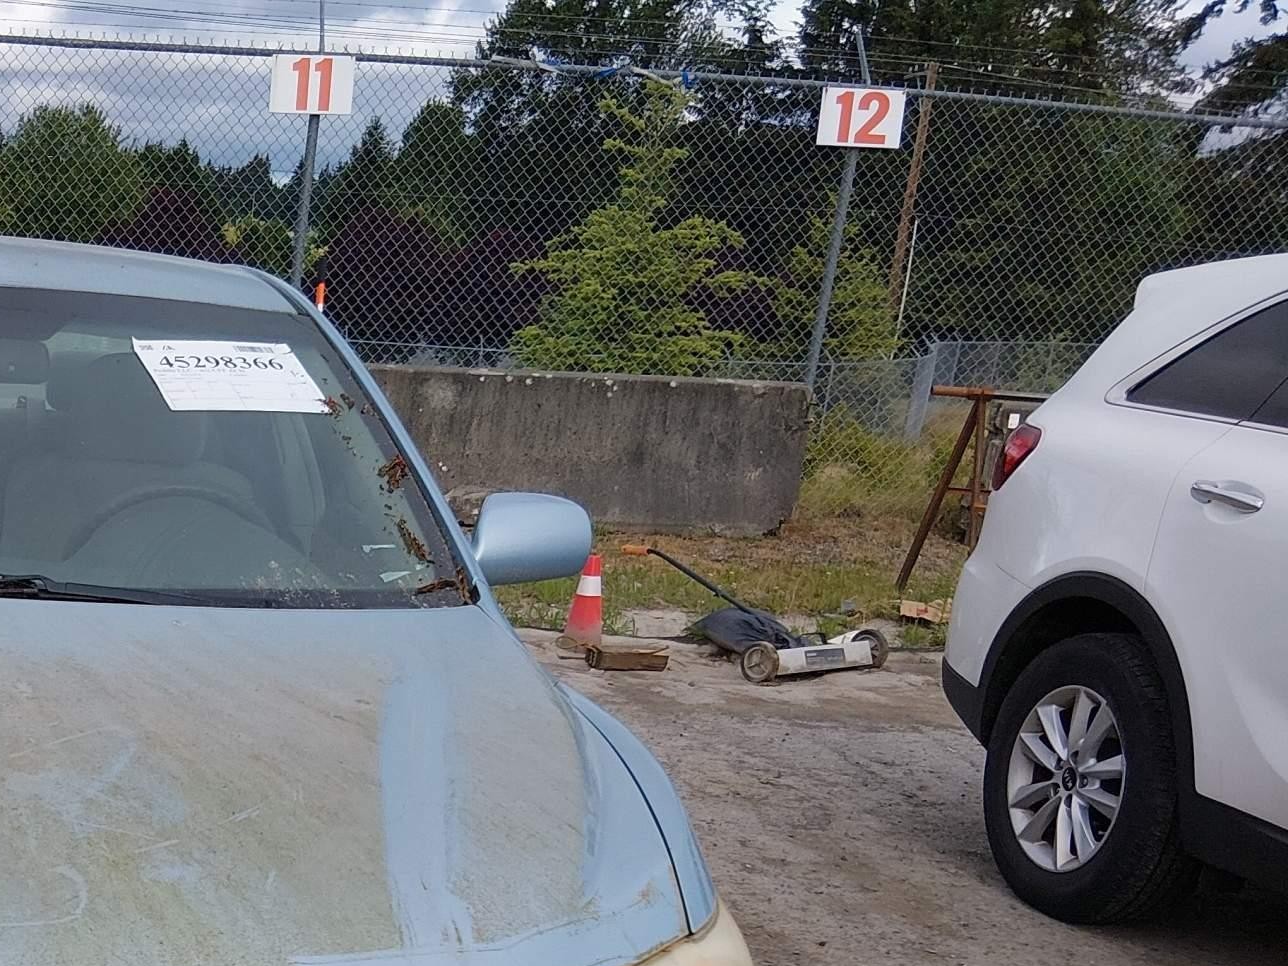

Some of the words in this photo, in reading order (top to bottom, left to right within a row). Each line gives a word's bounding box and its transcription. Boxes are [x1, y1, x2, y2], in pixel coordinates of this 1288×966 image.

[292, 58, 332, 110] 11
[836, 91, 890, 144] 12
[159, 355, 284, 371] 45298366
